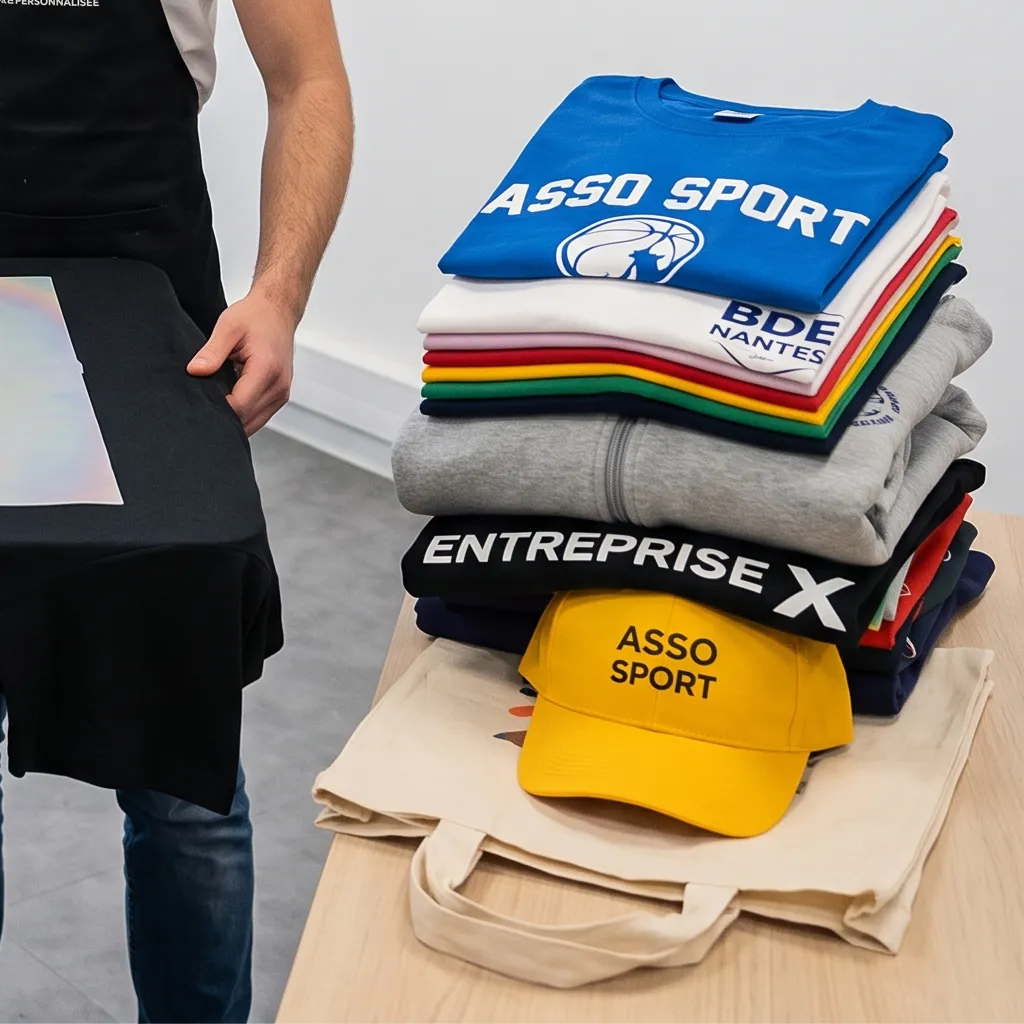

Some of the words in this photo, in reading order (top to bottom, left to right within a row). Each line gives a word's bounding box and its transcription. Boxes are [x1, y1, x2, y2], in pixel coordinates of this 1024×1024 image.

[481, 173, 652, 216] ASSO
[663, 177, 871, 245] SPORT
[709, 324, 826, 365] NANTES
[721, 300, 840, 346] BDE
[423, 532, 769, 593] ENTREPRISE
[773, 564, 855, 631] X
[617, 626, 717, 666] ASSO
[611, 660, 716, 699] SPORT
